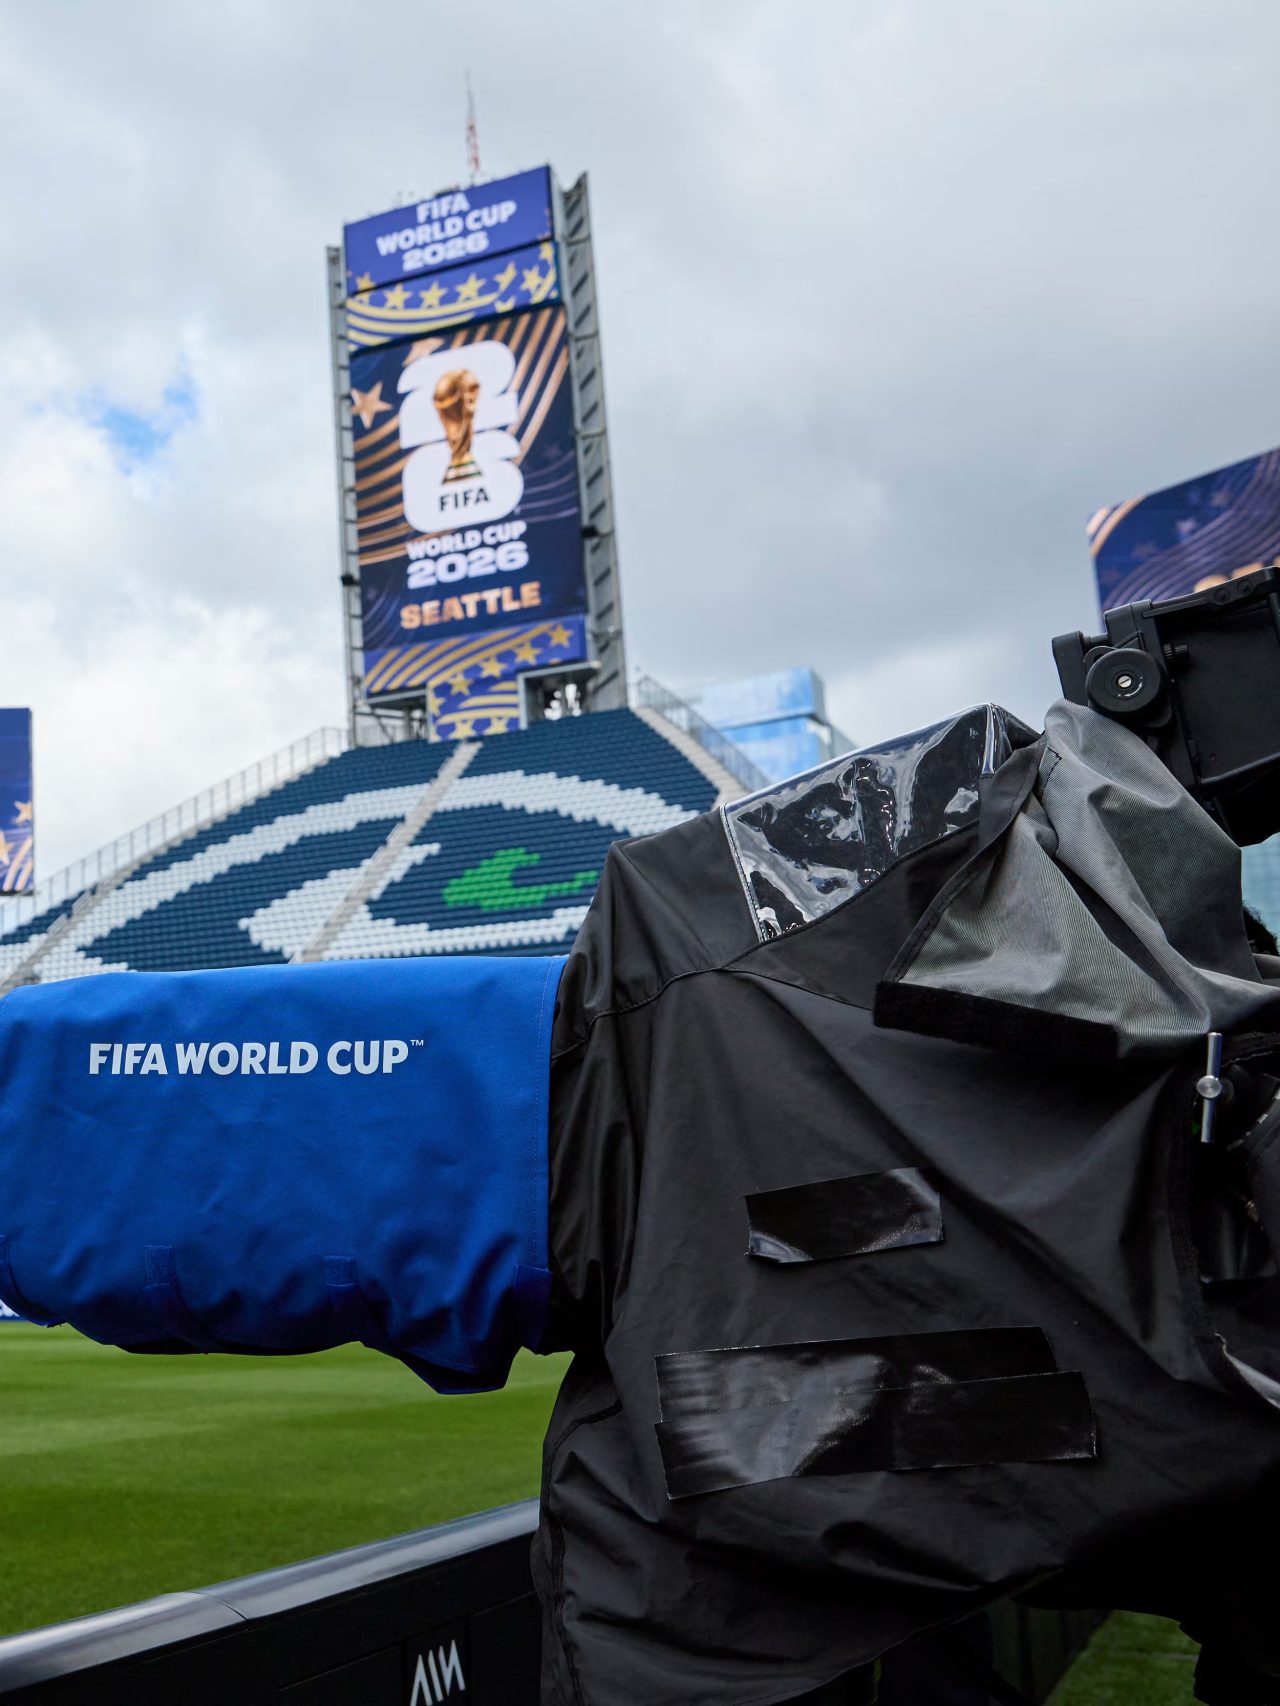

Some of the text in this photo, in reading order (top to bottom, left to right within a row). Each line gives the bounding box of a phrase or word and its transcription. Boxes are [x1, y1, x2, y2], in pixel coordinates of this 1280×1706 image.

[416, 192, 471, 223] FIFA
[375, 200, 518, 256] WORLD CUP
[402, 231, 489, 271] 2026
[439, 488, 489, 512] FIFA
[405, 520, 527, 560] WORLD CUP
[406, 541, 529, 589] 2026
[400, 581, 541, 629] SEATTLE
[89, 1043, 168, 1075] FIFA
[175, 1042, 318, 1076] WORLD
